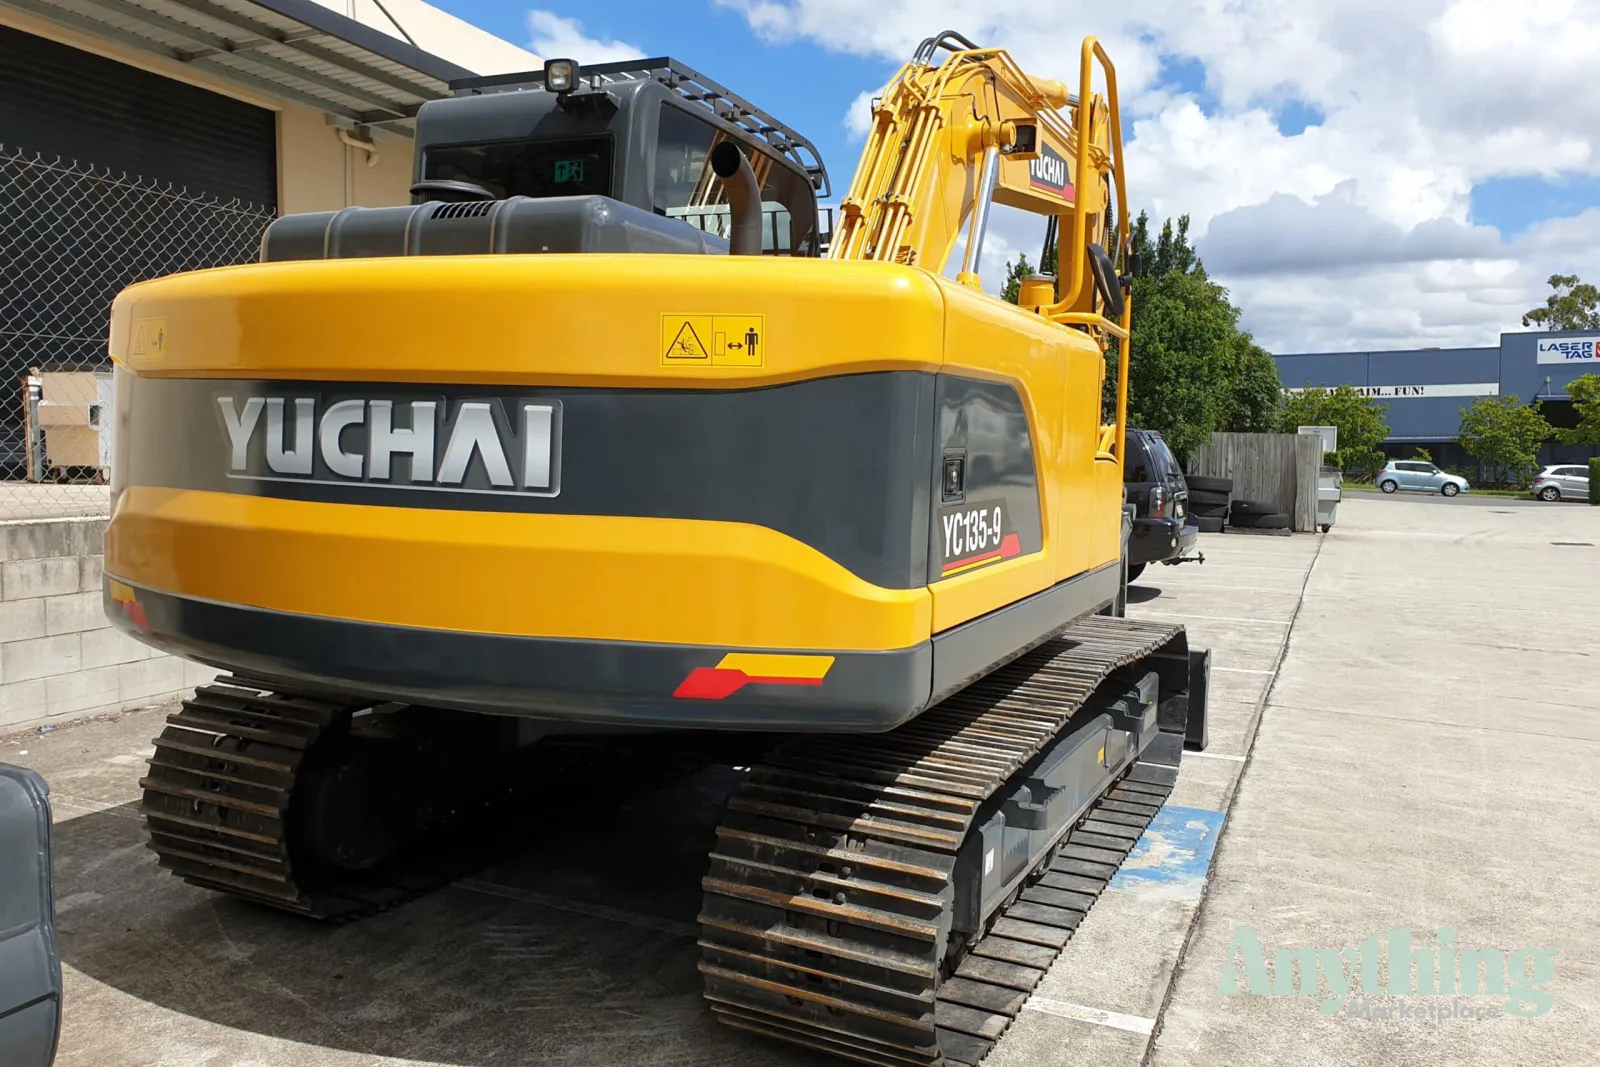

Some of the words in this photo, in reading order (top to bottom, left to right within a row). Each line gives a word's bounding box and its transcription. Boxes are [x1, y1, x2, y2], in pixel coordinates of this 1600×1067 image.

[1030, 153, 1065, 187] YUCHAI
[1539, 341, 1593, 351] LASER
[1560, 350, 1593, 359] TAG
[1394, 386, 1424, 396] FUN!
[217, 396, 554, 489] YUCHAI
[943, 506, 1002, 558] YC135-9
